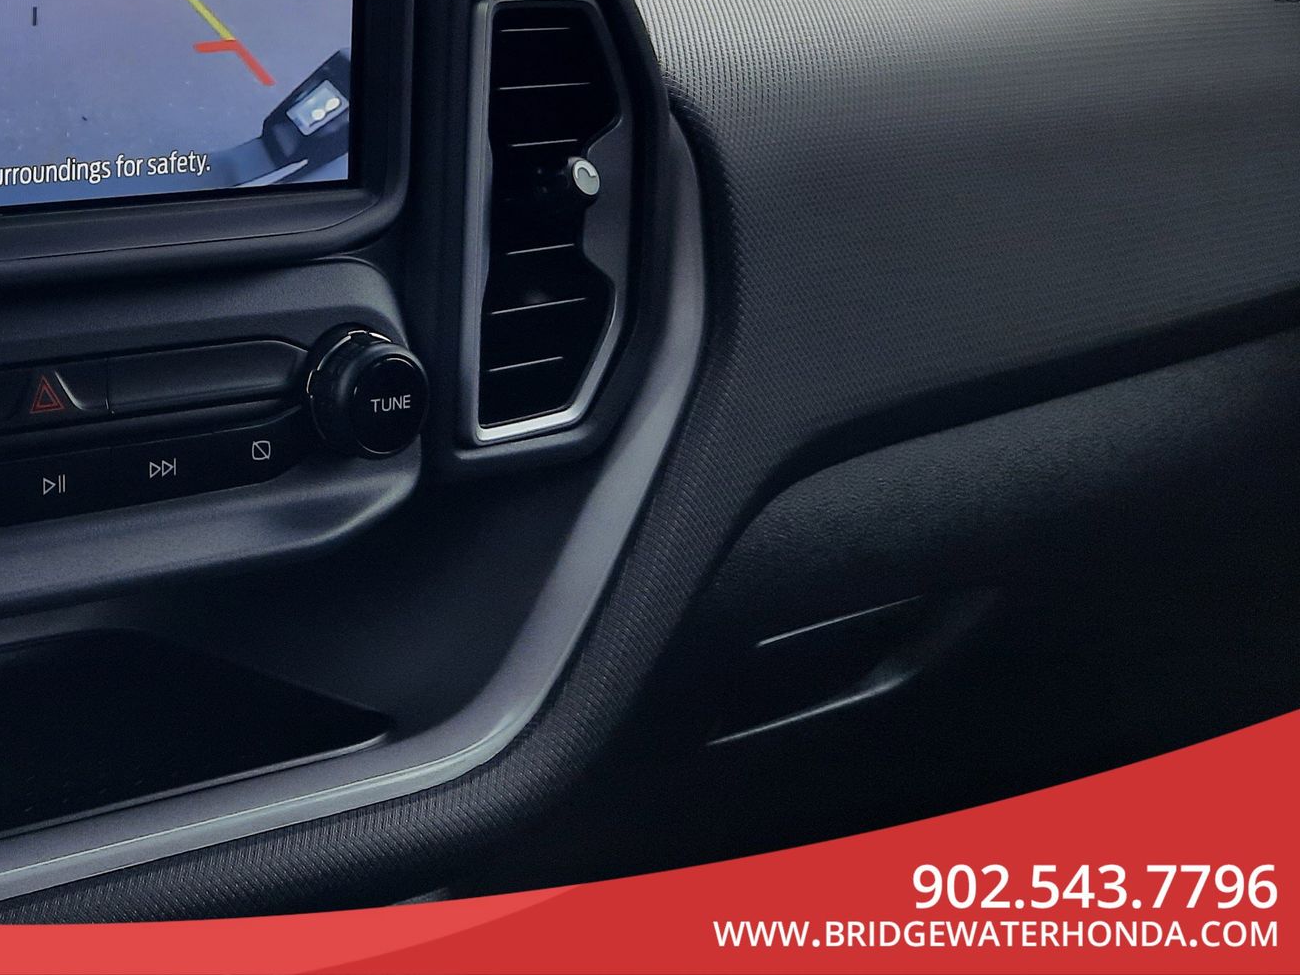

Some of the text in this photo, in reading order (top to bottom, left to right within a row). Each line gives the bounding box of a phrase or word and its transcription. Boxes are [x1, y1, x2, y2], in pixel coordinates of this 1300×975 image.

[115, 153, 144, 178] for
[146, 150, 212, 176] safety.
[369, 394, 412, 413] TUNE
